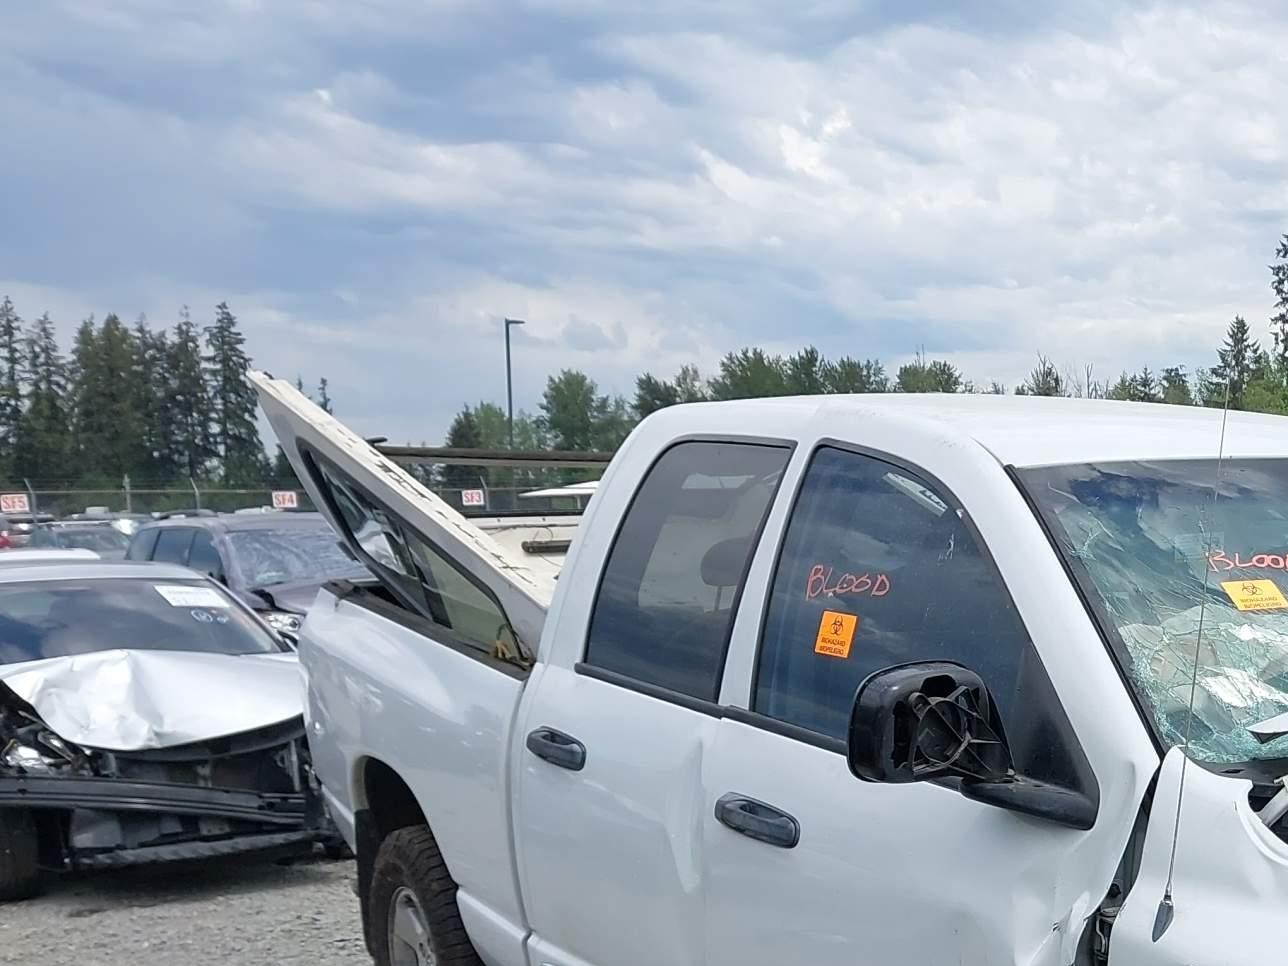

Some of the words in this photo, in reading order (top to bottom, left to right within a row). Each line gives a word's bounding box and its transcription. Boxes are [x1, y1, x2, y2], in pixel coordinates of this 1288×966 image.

[3, 496, 26, 509] SF5
[463, 491, 482, 504] SF3
[806, 564, 890, 601] BLOOD
